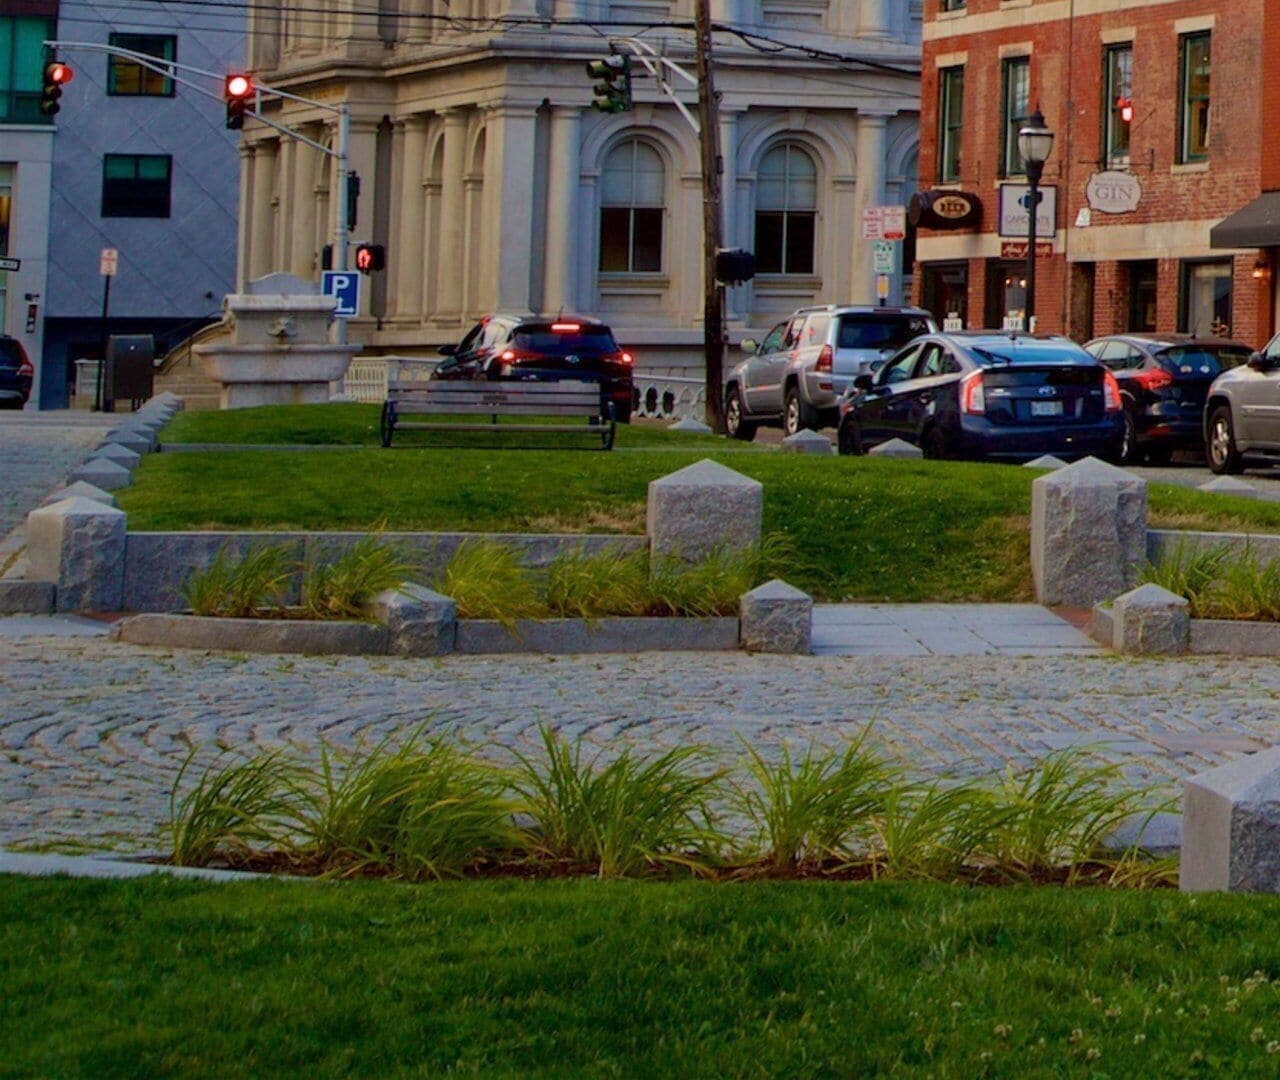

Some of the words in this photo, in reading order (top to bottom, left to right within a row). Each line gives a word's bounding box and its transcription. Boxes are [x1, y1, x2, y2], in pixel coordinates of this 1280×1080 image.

[1095, 186, 1133, 200] GIN
[940, 202, 965, 212] BEER
[332, 275, 350, 296] P
